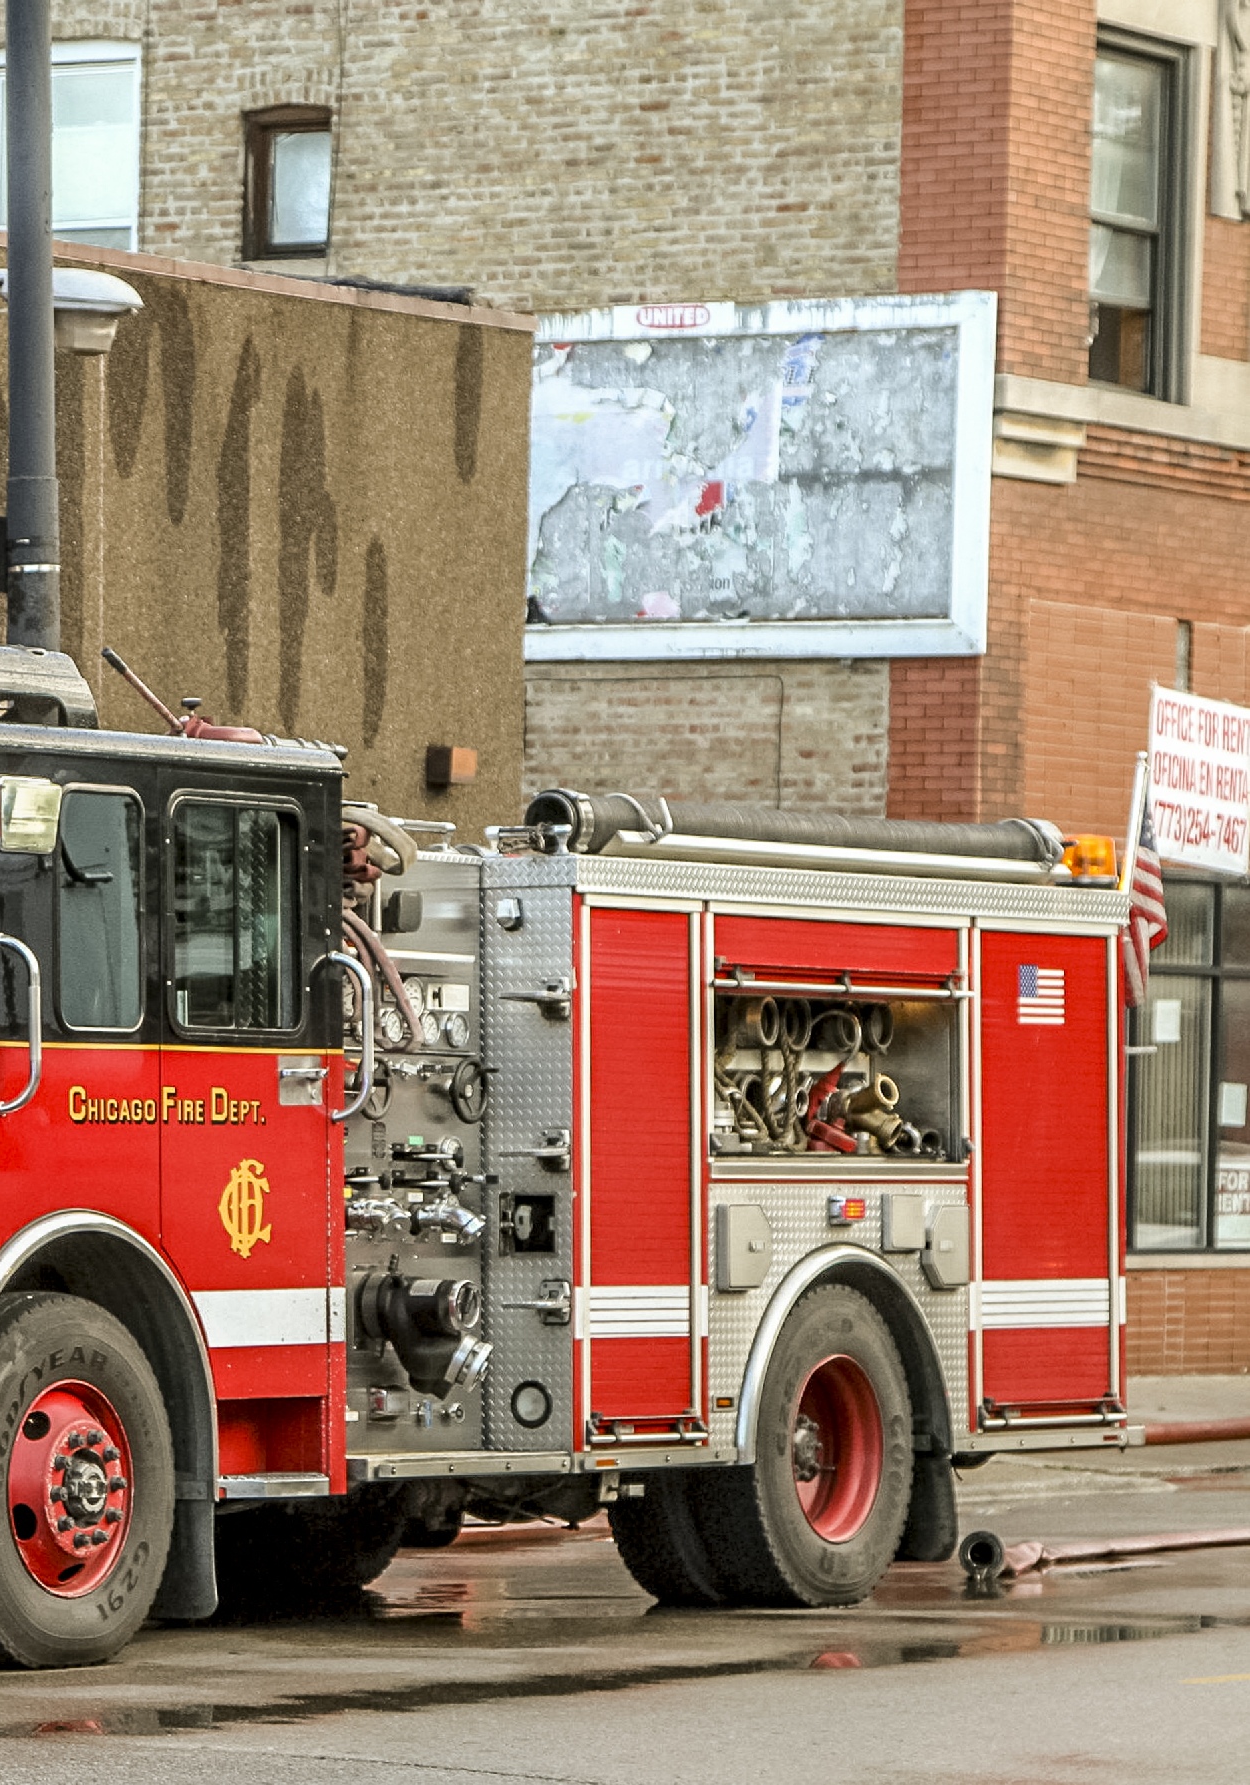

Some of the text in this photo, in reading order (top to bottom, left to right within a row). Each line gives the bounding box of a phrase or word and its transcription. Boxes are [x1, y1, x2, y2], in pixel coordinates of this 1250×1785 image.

[638, 305, 710, 328] UNITED
[1156, 699, 1195, 743] OFFICE
[1198, 709, 1220, 748] FOR
[1153, 751, 1249, 805] OFICINA EN RENTA
[68, 1085, 157, 1124] CHICAGO
[161, 1085, 205, 1124] FIRE
[1220, 1171, 1249, 1191] FOR
